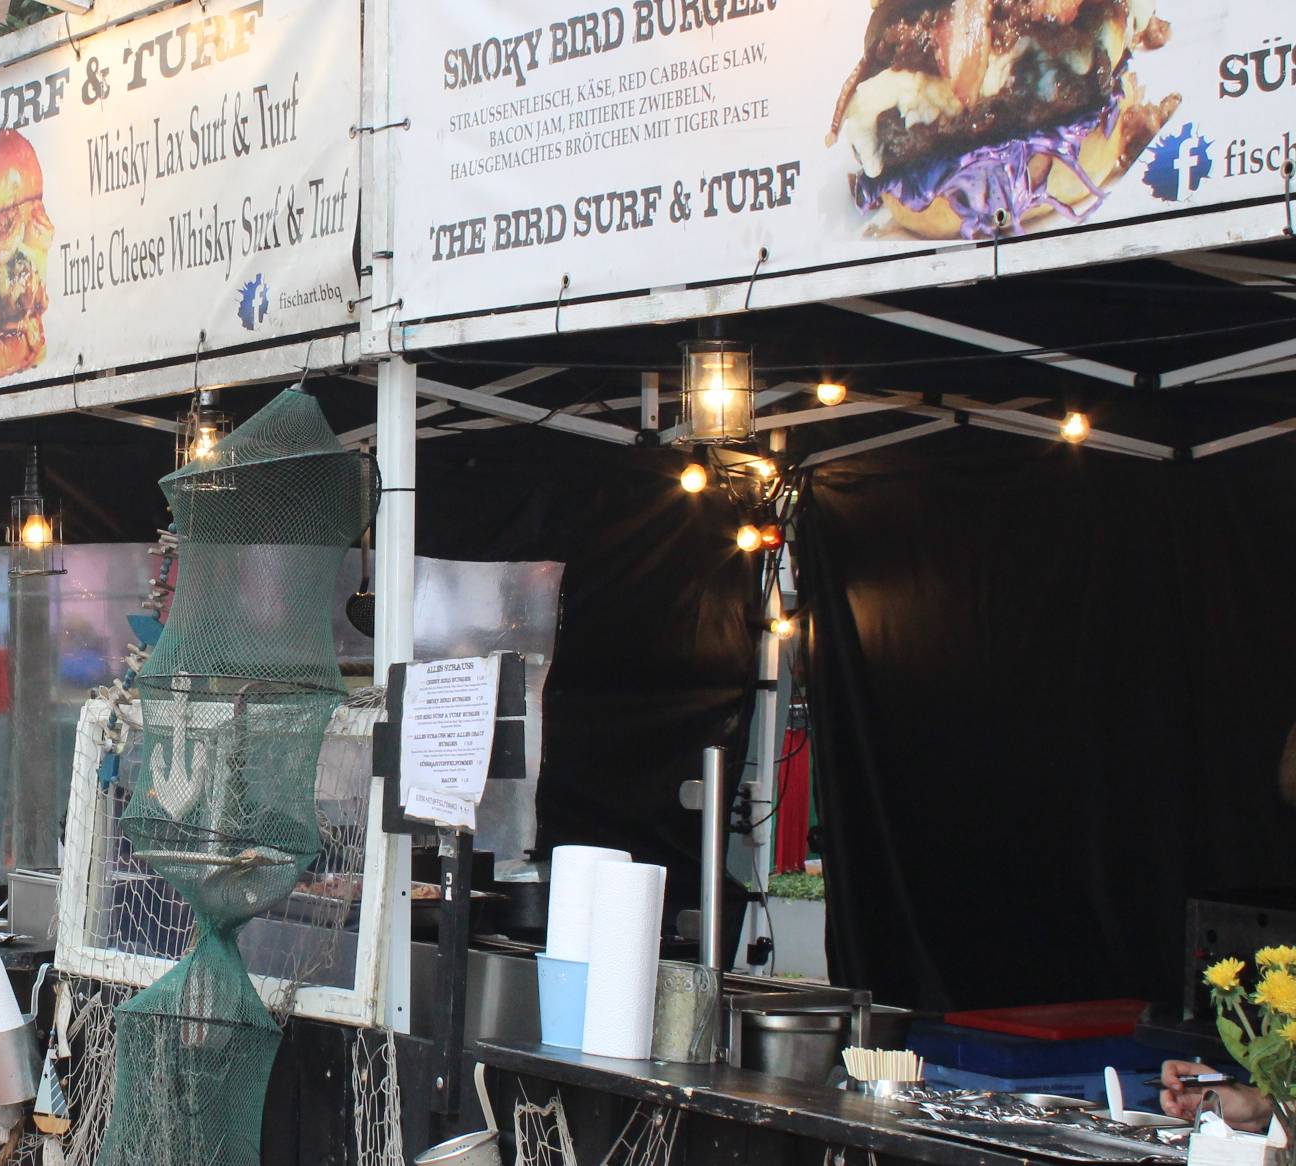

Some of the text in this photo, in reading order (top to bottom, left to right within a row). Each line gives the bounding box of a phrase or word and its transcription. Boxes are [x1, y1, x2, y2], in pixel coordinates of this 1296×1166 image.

[81, 56, 110, 106] &
[123, 2, 264, 92] TURF
[443, 28, 543, 90] SMOKY
[548, 7, 624, 64] BIRD
[449, 43, 768, 132] STRAUSSENFLEISCH, KÄSE, RED CABBAGE SLAW,
[1218, 36, 1296, 99] SÜ
[87, 72, 299, 206] Whisky Lax Surf & Turf
[450, 99, 770, 180] HAUSGEMACHTES BRÖTCHEN MIT TIGER PASTE
[489, 83, 716, 148] BACON JAM, FRITIERTE ZWIEBELN,
[60, 168, 349, 312] Triple Cheese Whisky Surf & Turf
[429, 160, 801, 261] THE BIRD SURF & TURF
[279, 282, 344, 310] fischart.bbq
